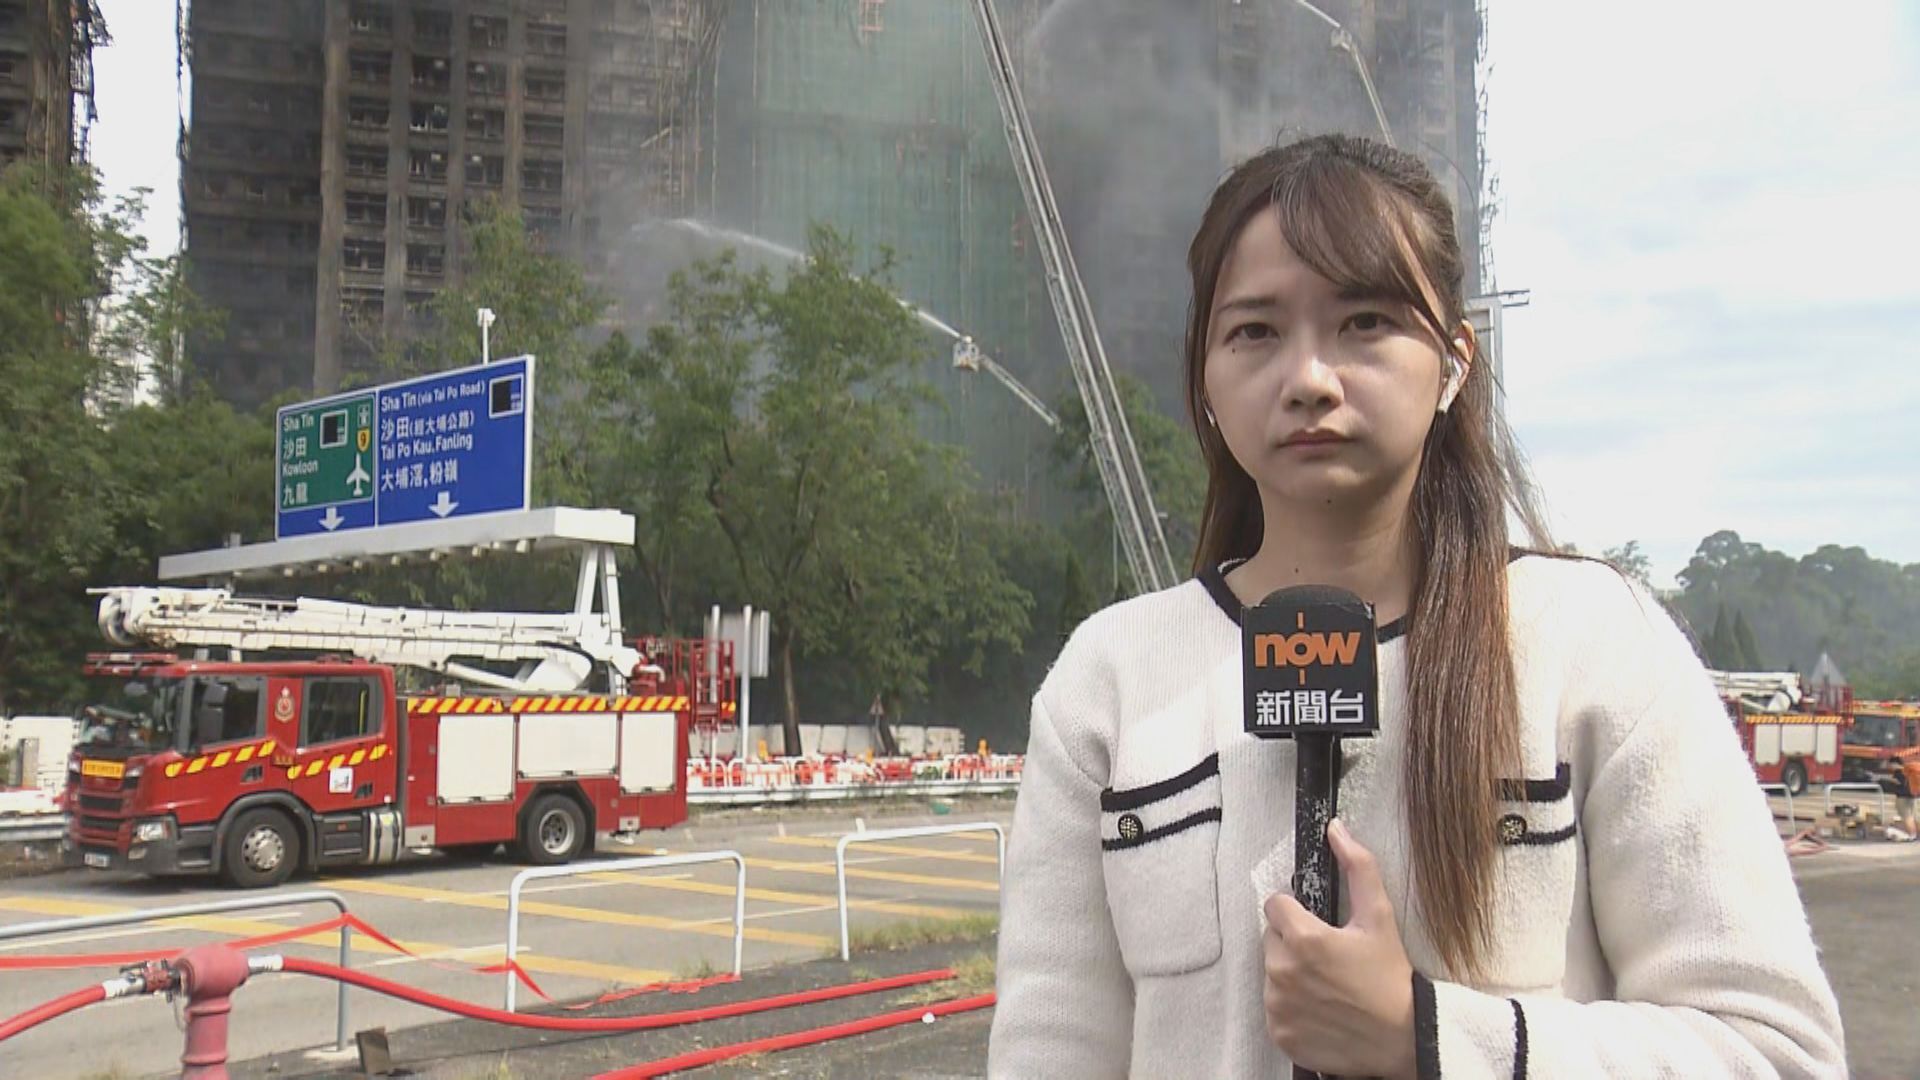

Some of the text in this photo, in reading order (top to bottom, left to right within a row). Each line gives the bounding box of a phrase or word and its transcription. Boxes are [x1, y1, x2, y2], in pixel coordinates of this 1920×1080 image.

[381, 396, 399, 412] Sha
[402, 392, 416, 408] Tin
[434, 388, 445, 401] Tai
[447, 386, 458, 398] Po
[460, 380, 485, 395] Road)
[284, 414, 314, 432] Sha Tin
[283, 436, 306, 459] 沙田
[381, 444, 395, 460] Tai
[397, 442, 410, 458] Po
[435, 432, 472, 451] Fanling
[282, 460, 318, 477] Kowloon
[1255, 632, 1361, 667] now
[1256, 688, 1363, 726] 新聞台
